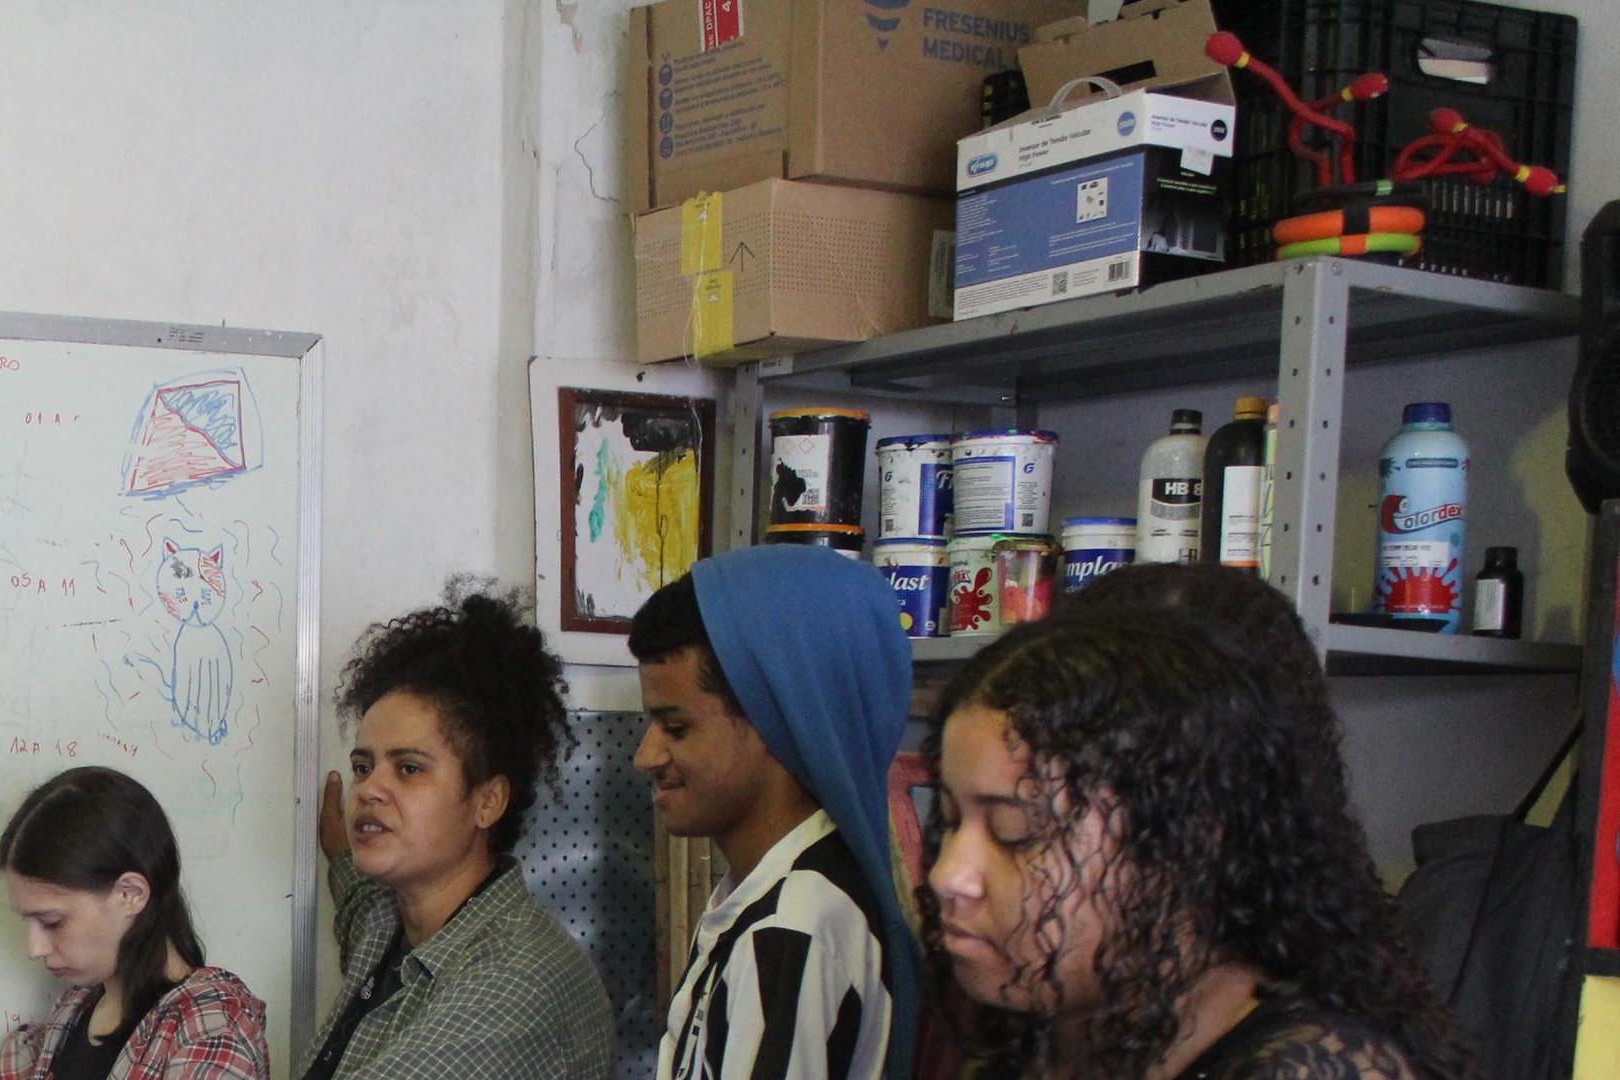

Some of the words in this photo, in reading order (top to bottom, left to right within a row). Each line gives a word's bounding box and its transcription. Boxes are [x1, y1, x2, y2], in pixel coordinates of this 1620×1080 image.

[923, 7, 1030, 44] FRESENIUS
[25, 412, 43, 425] 01
[54, 413, 61, 425] A
[1164, 482, 1189, 495] HB
[1382, 494, 1464, 534] Colordex
[10, 573, 31, 588] 05
[37, 580, 46, 594] A
[61, 579, 75, 596] 11
[886, 571, 930, 591] last
[9, 737, 28, 753] 12
[32, 741, 41, 753] A
[56, 741, 78, 758] 18
